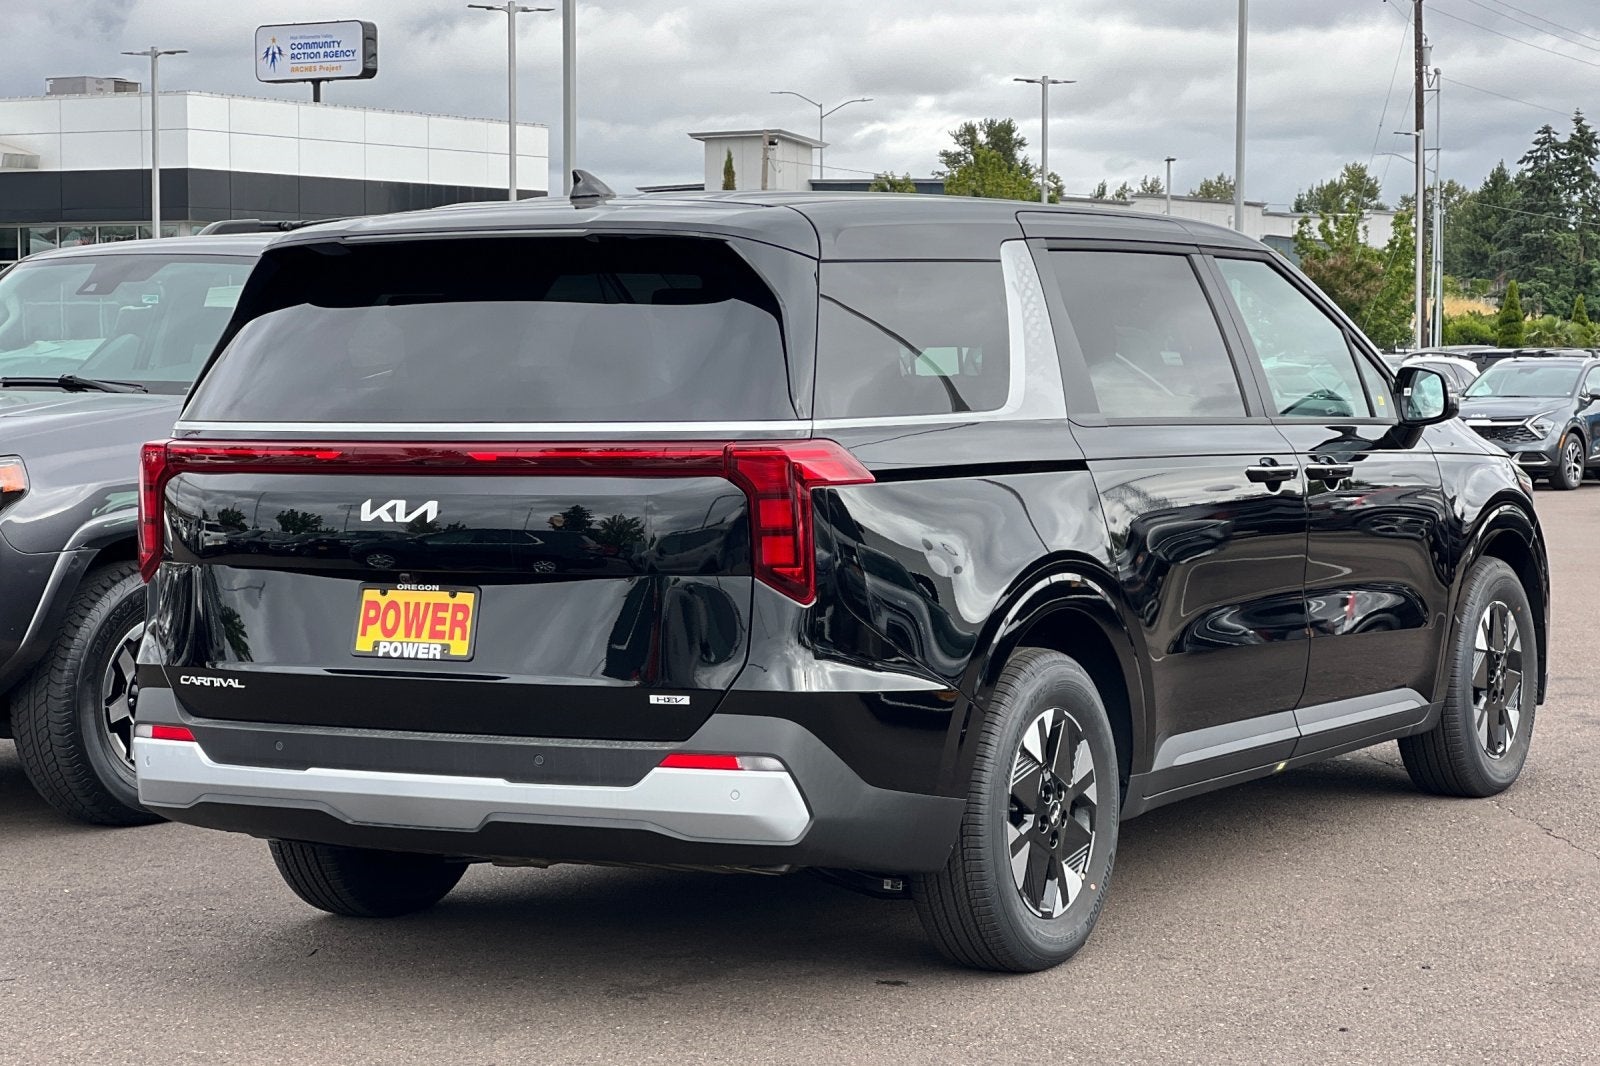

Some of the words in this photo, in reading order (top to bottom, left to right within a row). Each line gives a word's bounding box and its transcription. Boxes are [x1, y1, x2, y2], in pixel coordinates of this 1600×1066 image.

[290, 40, 342, 50] COMMUNITY
[290, 51, 321, 60] ACTION
[323, 49, 357, 59] AGENCY
[290, 65, 318, 73] ARCHES
[319, 64, 342, 73] Project
[360, 498, 439, 524] KIA
[396, 583, 440, 591] OREGON
[360, 600, 470, 641] POWER
[378, 642, 442, 659] POWER
[180, 675, 246, 689] CARNIVAL
